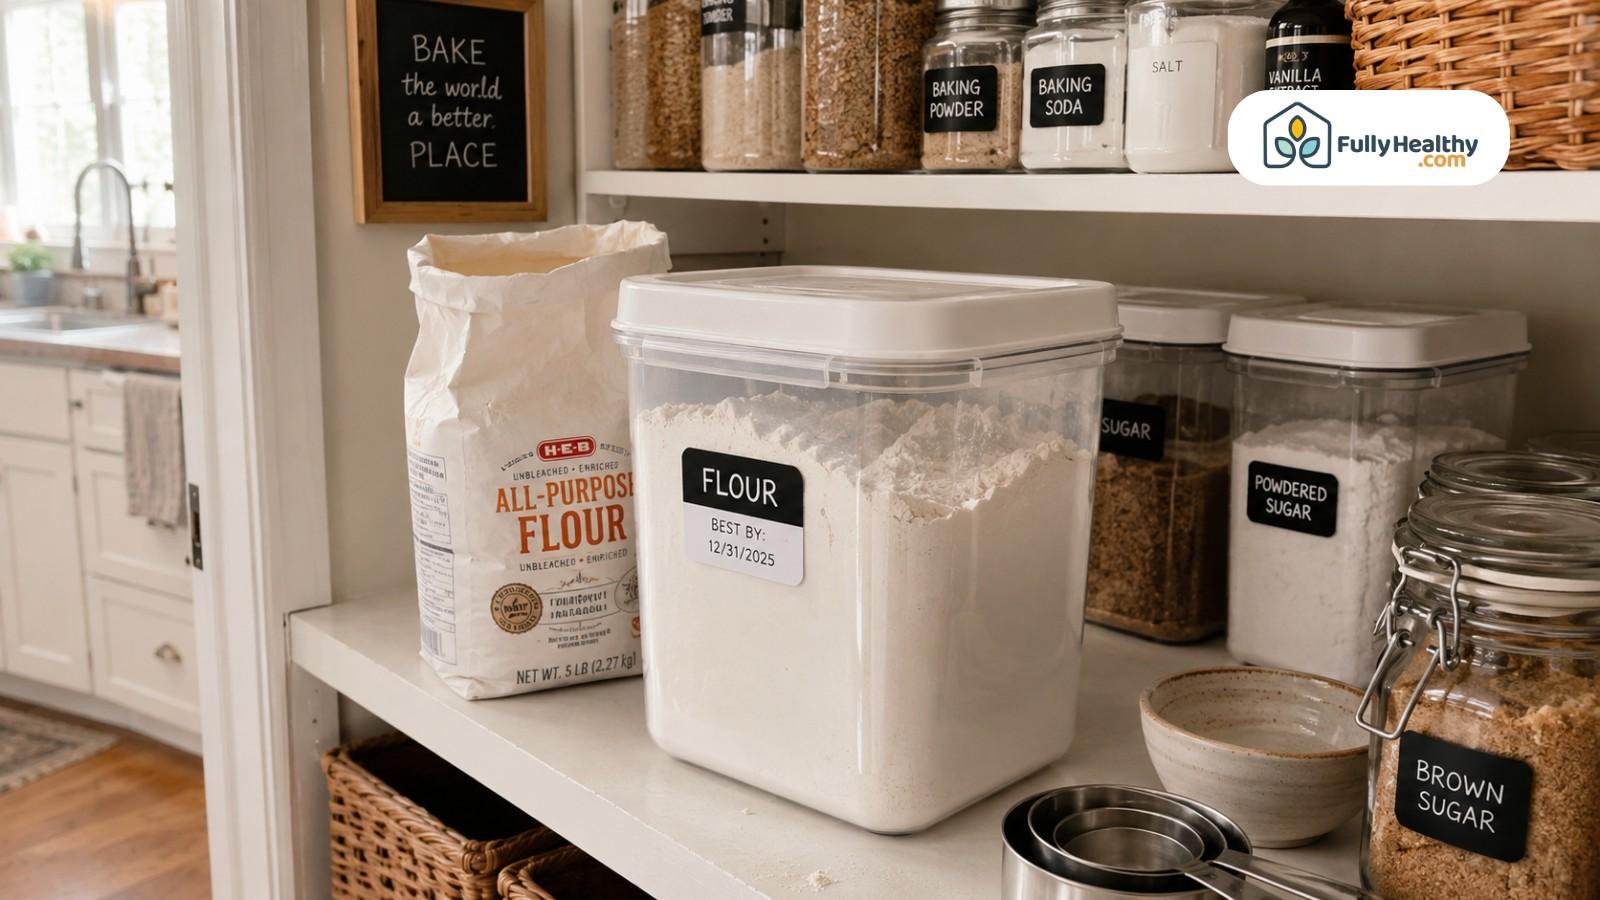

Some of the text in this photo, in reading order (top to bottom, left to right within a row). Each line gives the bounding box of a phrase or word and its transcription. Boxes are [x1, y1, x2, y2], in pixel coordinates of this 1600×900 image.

[412, 34, 486, 66] BAKE
[1152, 60, 1184, 74] SALT
[1269, 68, 1322, 85] VANILLA
[401, 72, 436, 96] the
[932, 79, 981, 98] BAKING
[1038, 76, 1092, 96] BAKING
[408, 110, 423, 126] a
[930, 100, 984, 119] POWDER
[1045, 98, 1083, 116] SODA
[410, 141, 498, 168] PLACE
[1101, 417, 1151, 440] SUGAR
[513, 466, 569, 481] UNBLEACHED
[702, 467, 778, 508] FLOUR
[1255, 474, 1328, 502] POWDERED
[1265, 497, 1312, 521] SUGAR
[518, 503, 627, 554] FLOUR
[711, 517, 766, 542] BEST BY:
[520, 558, 576, 572] UNBLEACHED
[709, 539, 775, 567] 12/31/2025
[516, 669, 538, 685] NET
[542, 666, 562, 681] WT.
[565, 665, 572, 678] 5
[575, 661, 588, 676] LB
[591, 656, 619, 675] (2.27
[1416, 759, 1504, 805] BROWN
[1418, 790, 1496, 834] SUGAR
